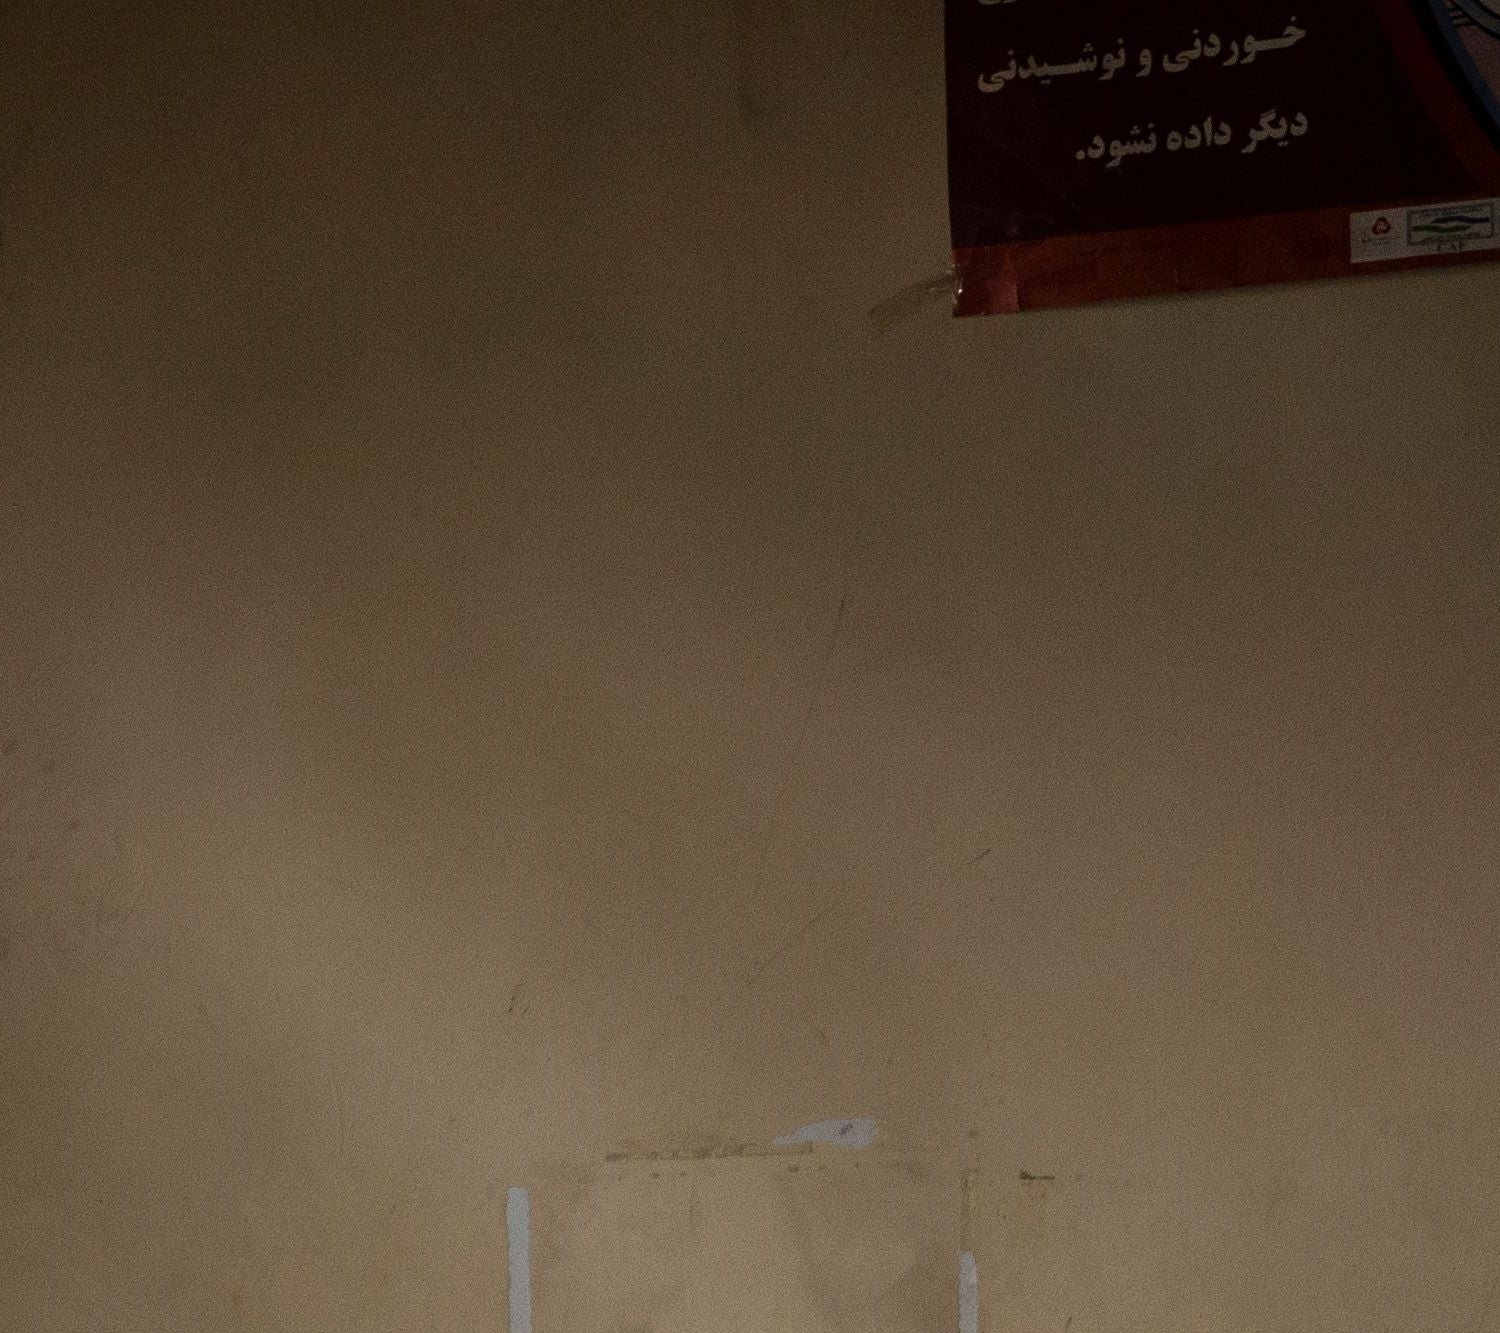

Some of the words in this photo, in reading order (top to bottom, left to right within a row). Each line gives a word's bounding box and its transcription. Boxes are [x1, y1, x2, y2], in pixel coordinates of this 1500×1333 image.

[976, 38, 1128, 94] نوشیدنی
[1135, 48, 1154, 77] و
[1162, 15, 1308, 73] خوردنی
[1074, 122, 1158, 168] نشود.
[1165, 115, 1233, 152] داده
[1239, 108, 1310, 154] دیگر
